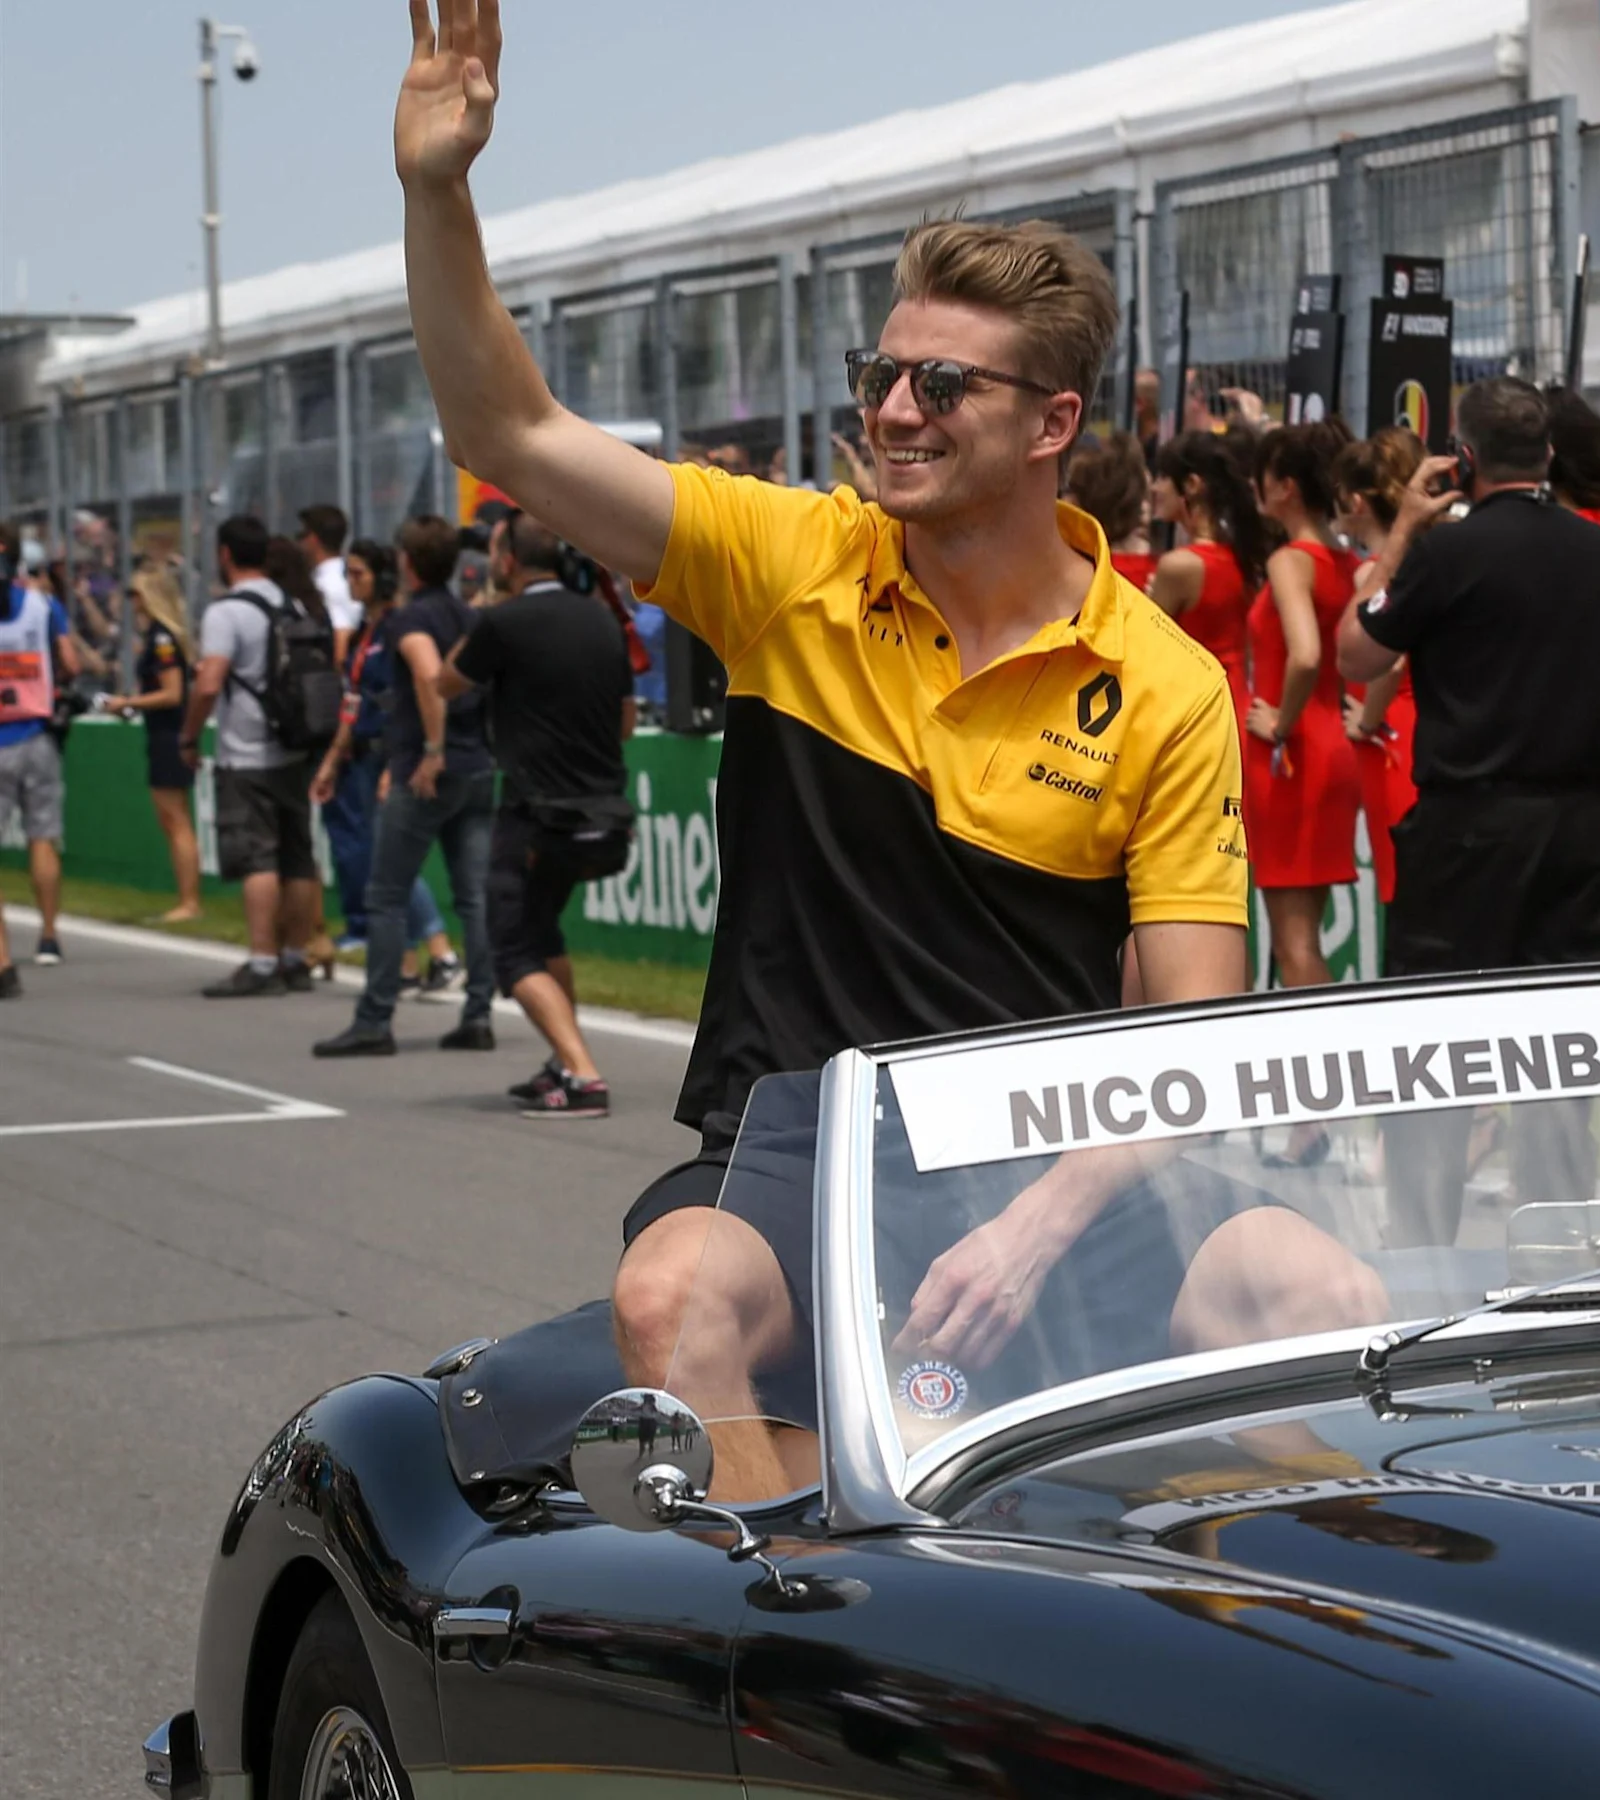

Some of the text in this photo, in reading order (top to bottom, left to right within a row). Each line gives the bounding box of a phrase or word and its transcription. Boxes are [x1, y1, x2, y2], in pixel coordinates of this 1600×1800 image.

[1040, 728, 1119, 766] RENAULT
[1044, 771, 1103, 802] Castrol
[1008, 1068, 1208, 1149] NICO
